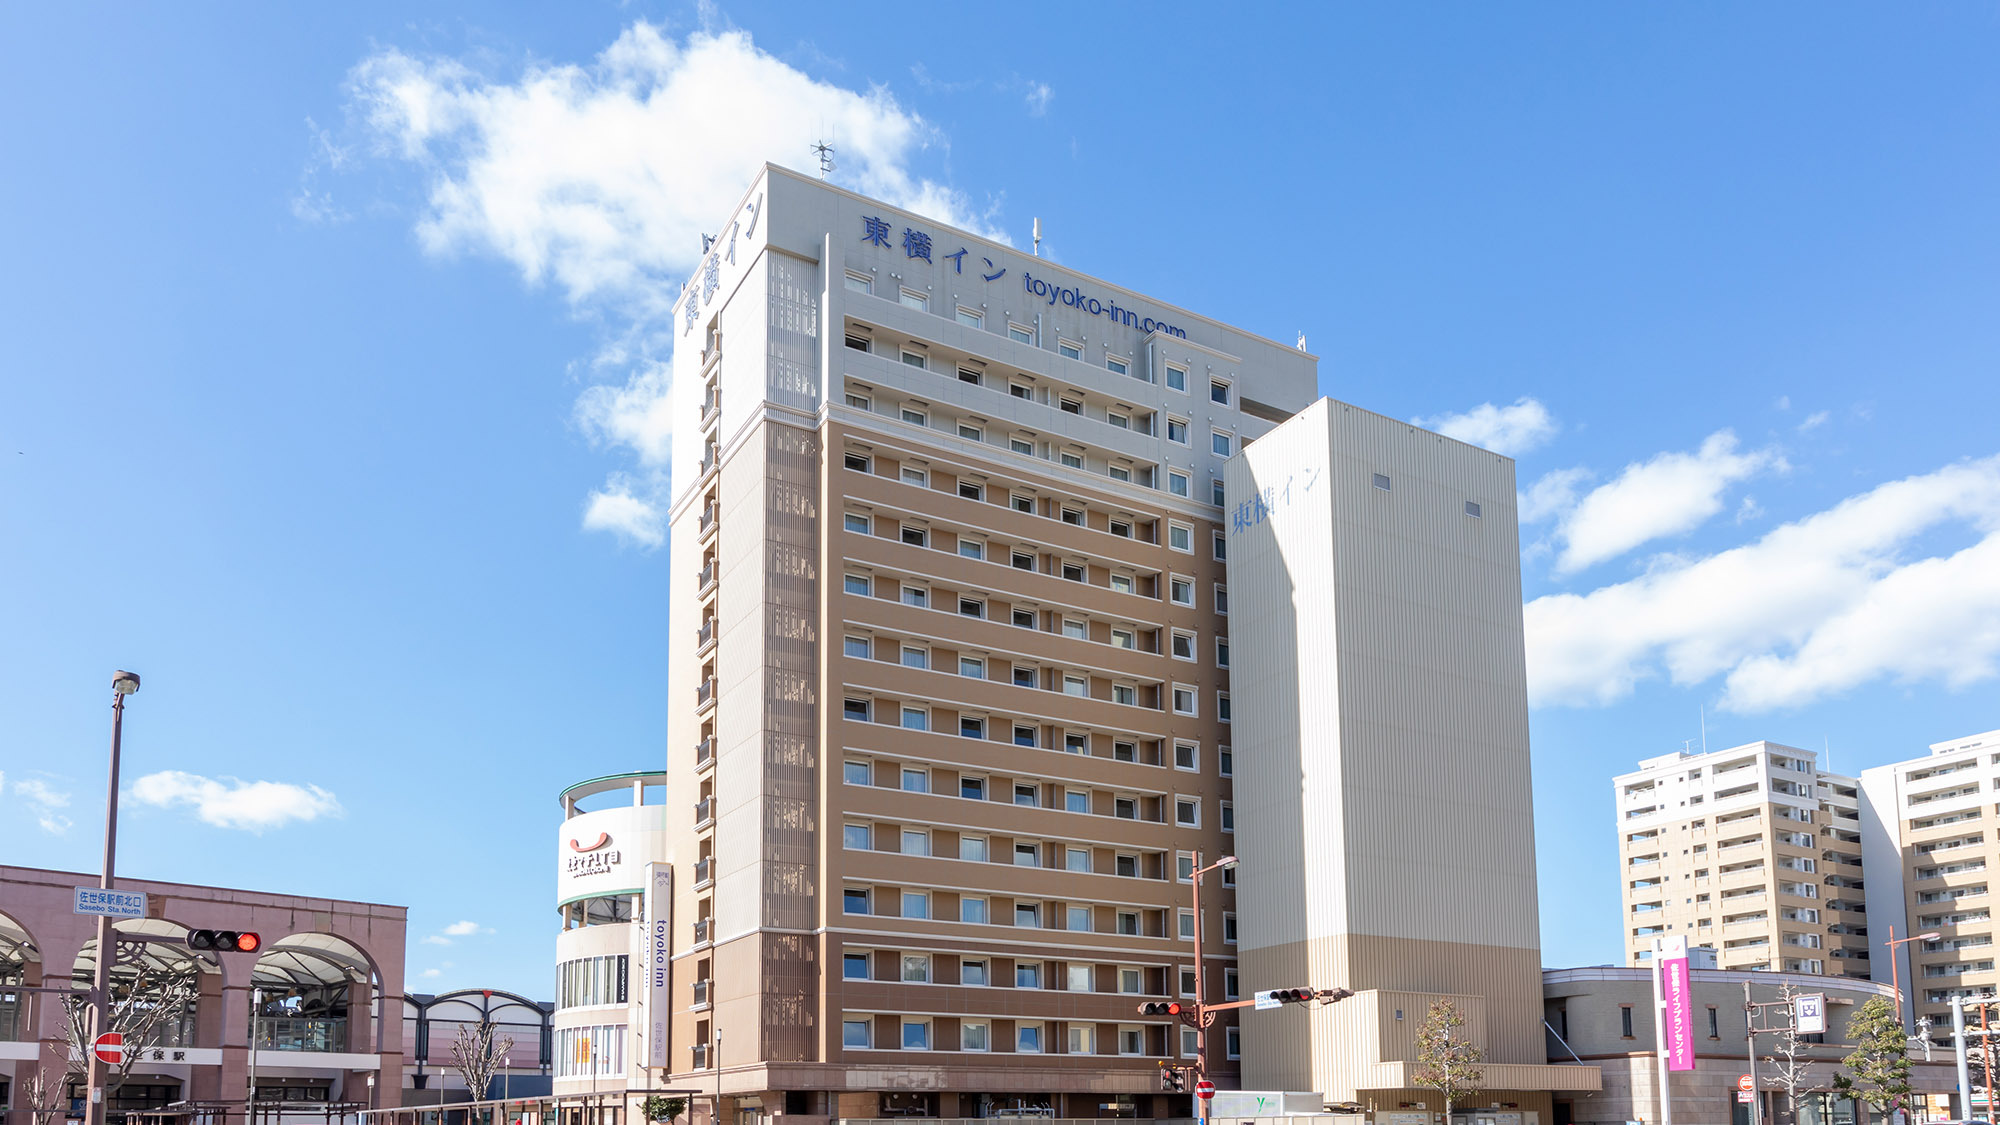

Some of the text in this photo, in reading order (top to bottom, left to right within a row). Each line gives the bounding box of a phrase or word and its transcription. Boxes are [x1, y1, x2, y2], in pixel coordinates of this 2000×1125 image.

[684, 191, 763, 337] 東横イン
[861, 215, 1006, 282] 東横イン
[1231, 467, 1321, 536] 東横イン
[78, 903, 105, 912] Sasebo
[121, 907, 141, 915] North
[79, 891, 142, 908] 佐世保駅前北口
[654, 919, 667, 988] toyoko inn
